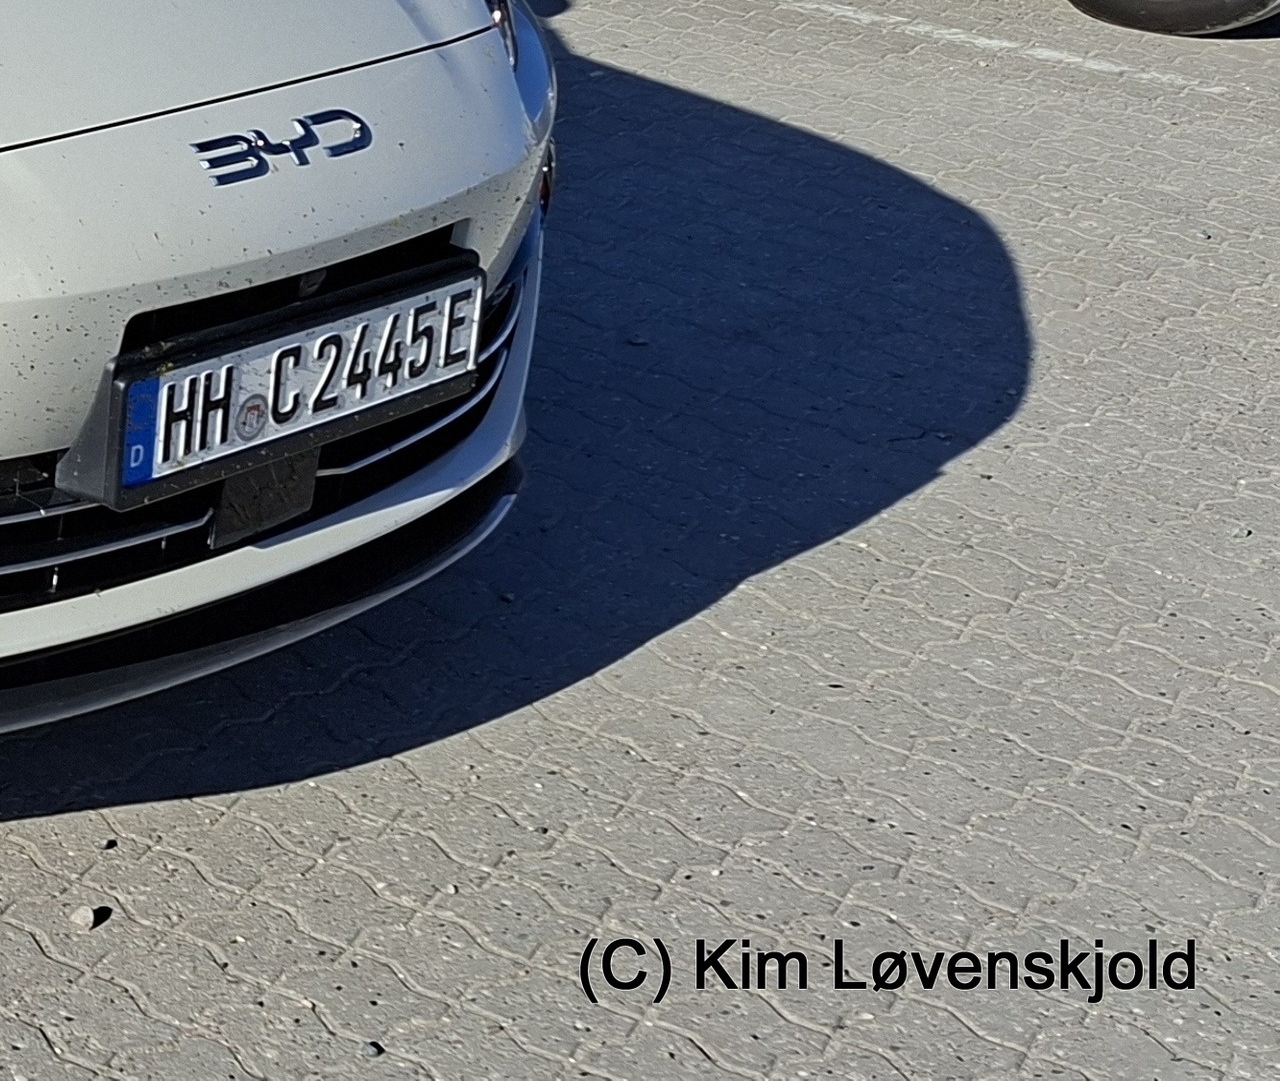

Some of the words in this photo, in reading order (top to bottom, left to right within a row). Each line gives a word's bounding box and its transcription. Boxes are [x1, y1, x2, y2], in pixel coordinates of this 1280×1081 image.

[189, 109, 372, 187] BYD
[156, 364, 234, 465] HH
[130, 444, 144, 468] D
